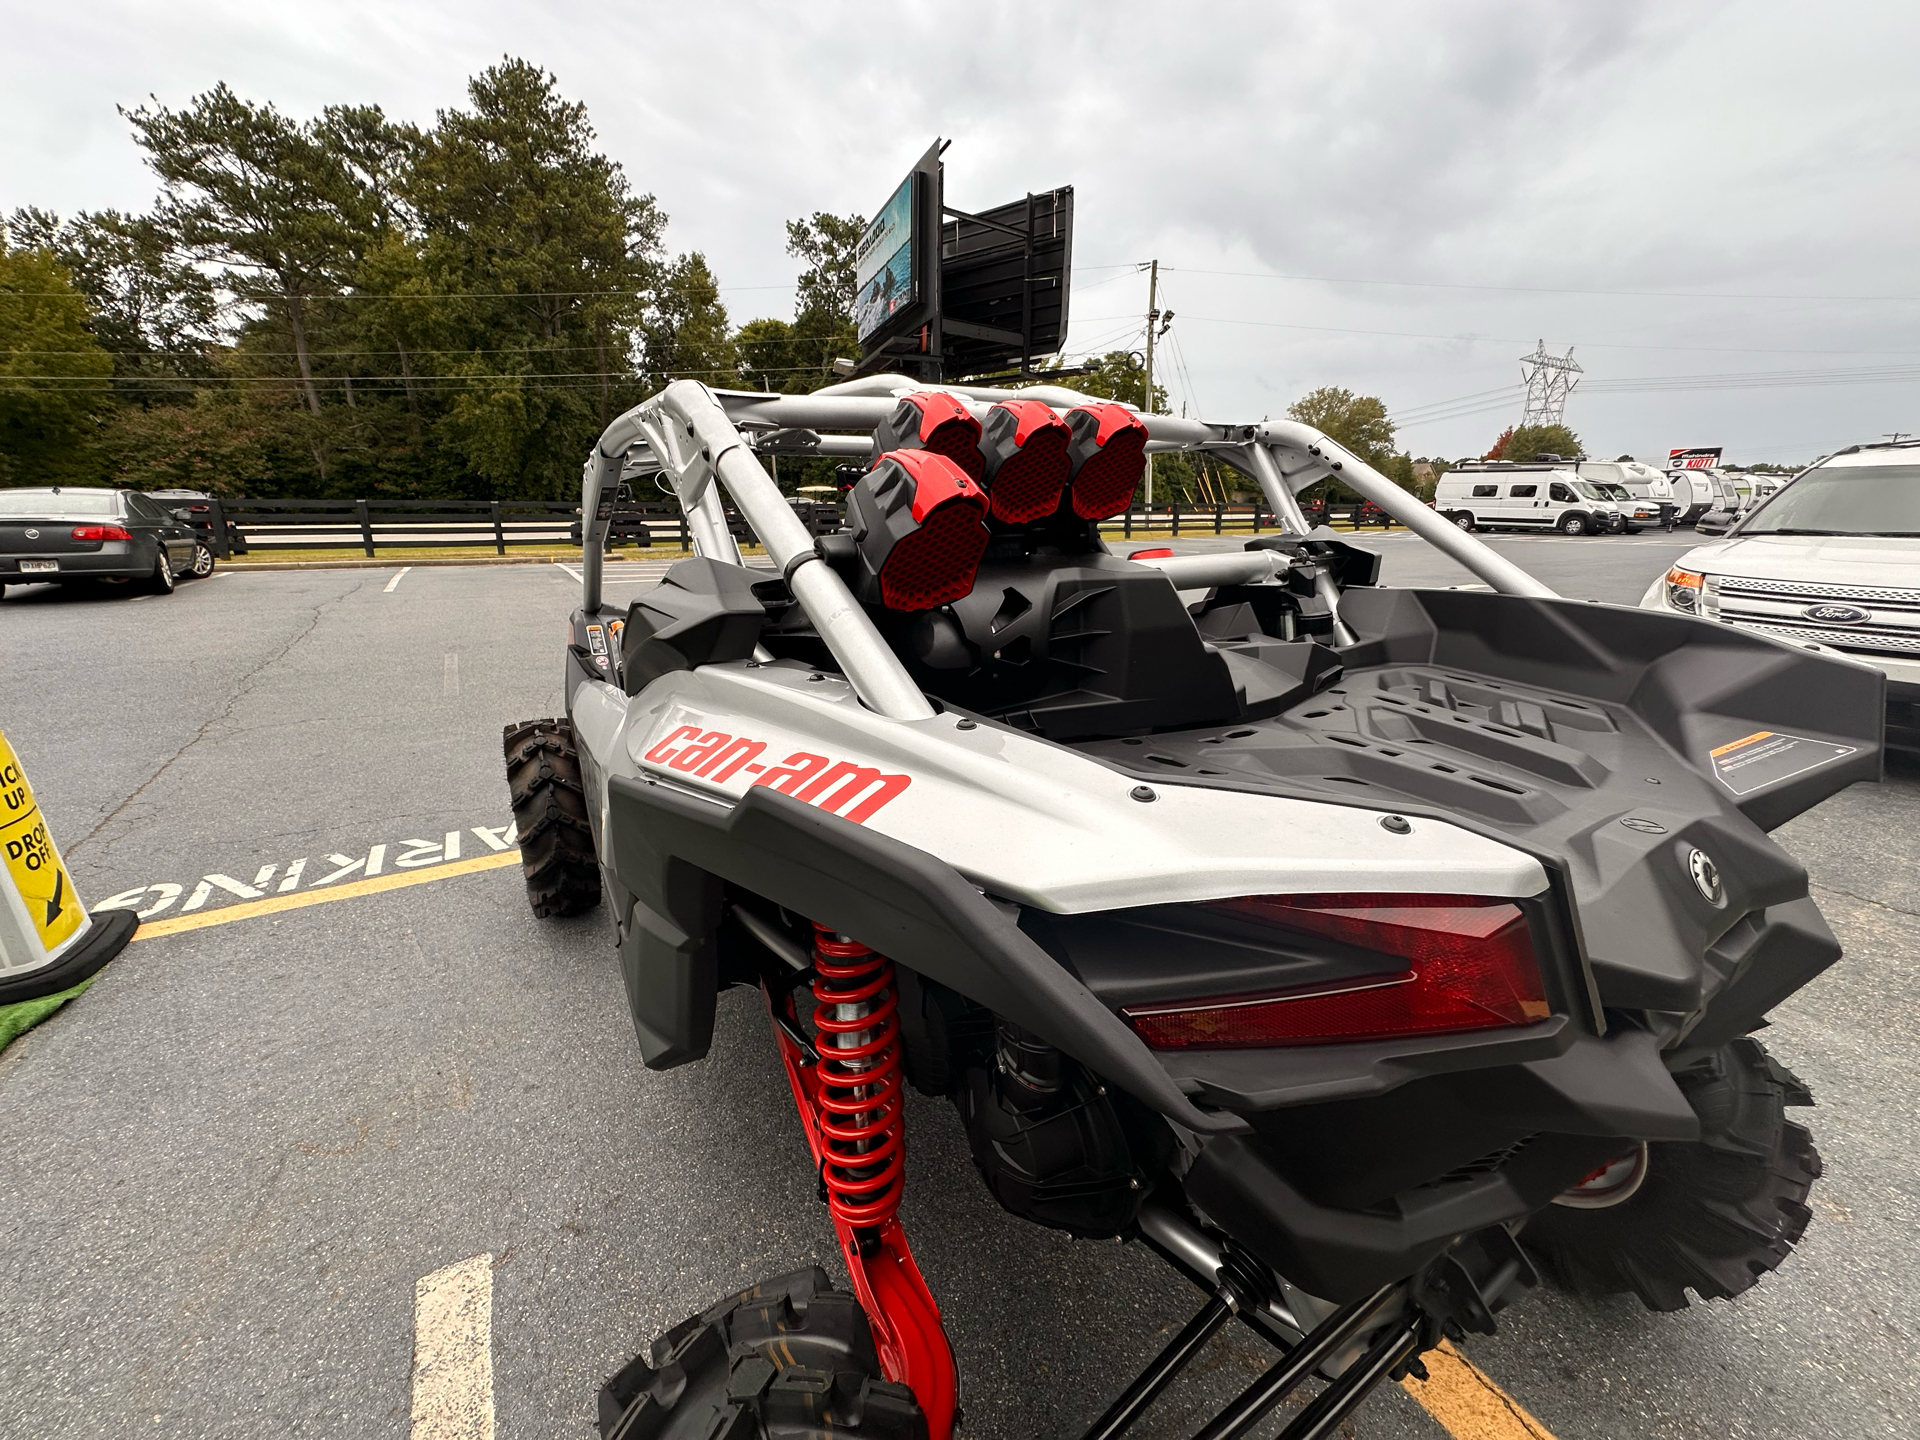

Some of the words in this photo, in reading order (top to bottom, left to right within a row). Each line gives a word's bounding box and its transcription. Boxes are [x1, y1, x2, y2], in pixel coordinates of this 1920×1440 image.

[1686, 458, 1715, 468] KIOTI
[1815, 607, 1853, 620] Ford
[0, 761, 21, 788] ICK
[644, 725, 912, 825] can-am
[4, 787, 25, 810] UP
[5, 822, 46, 860] DROP
[25, 842, 51, 871] OFF
[90, 820, 518, 919] ARKING
